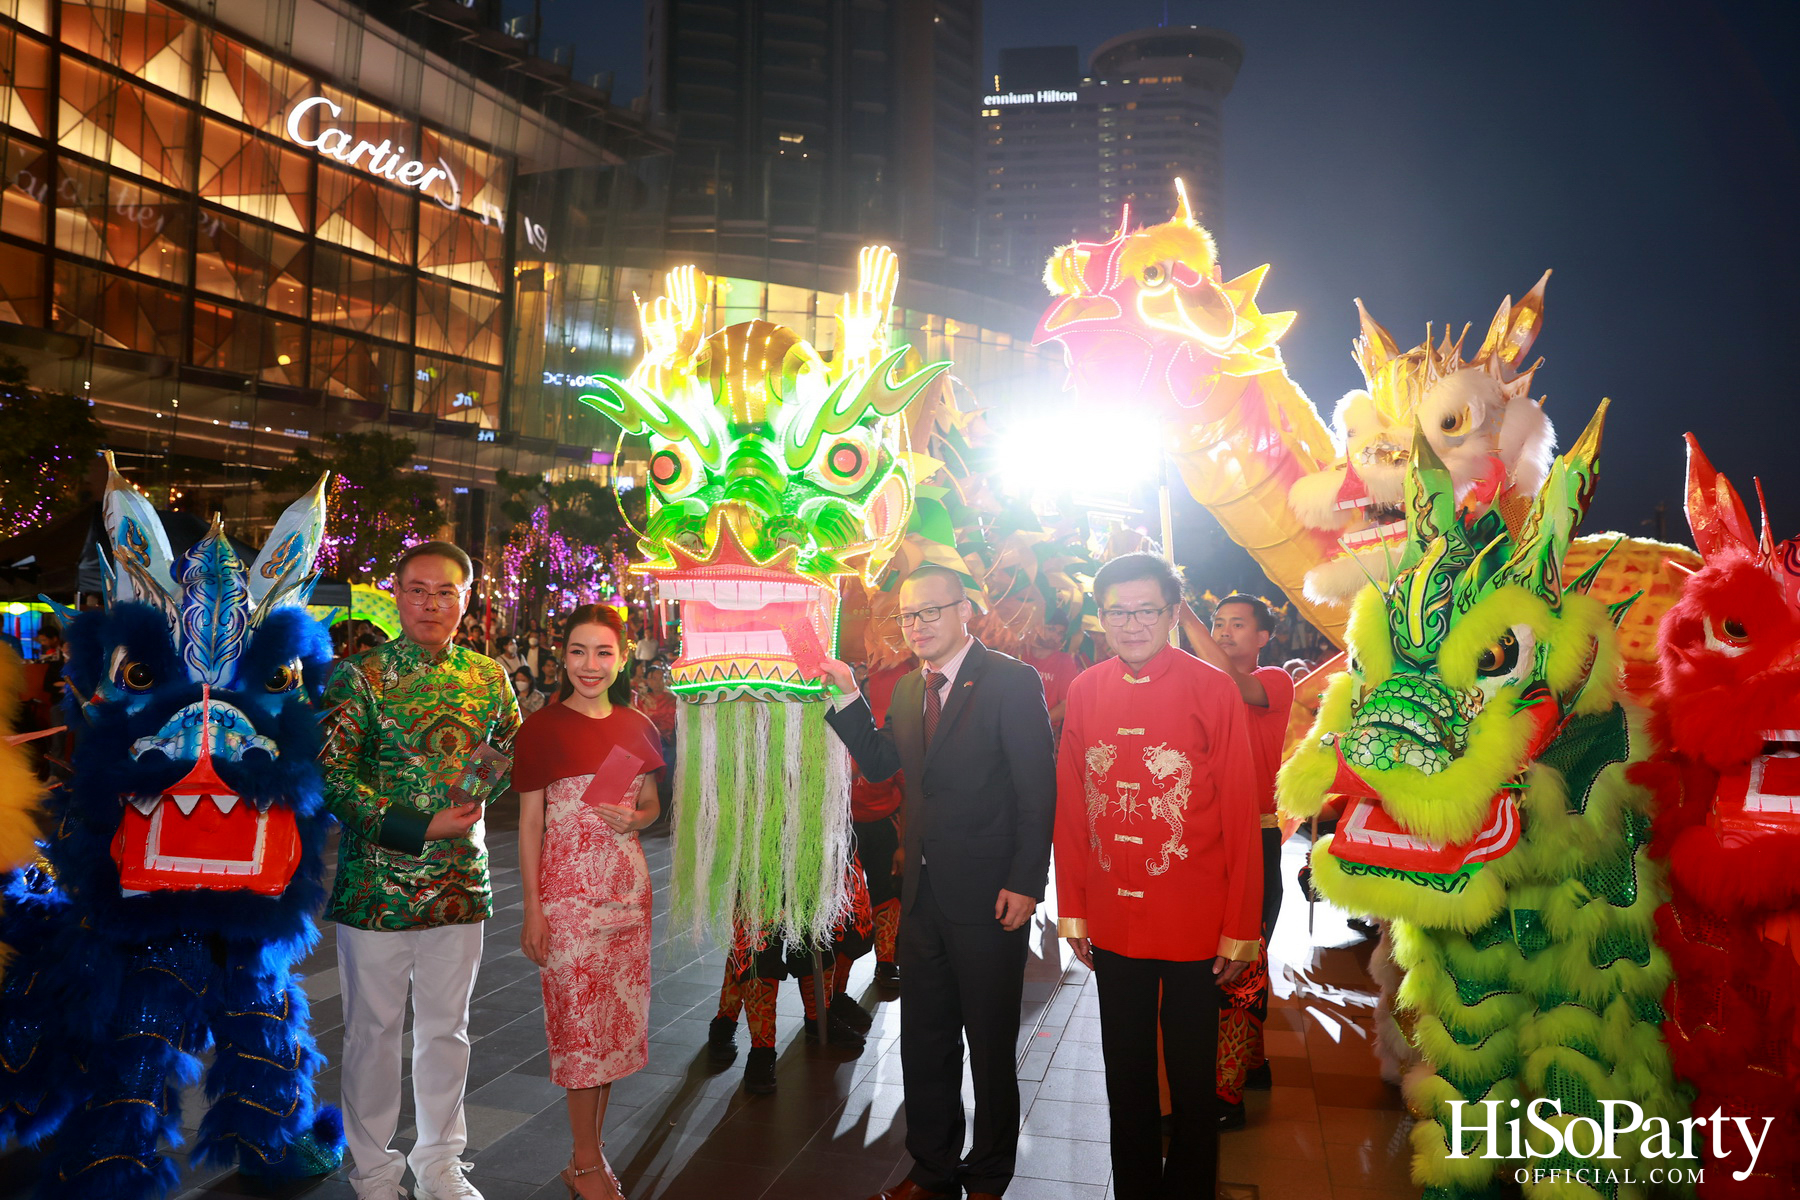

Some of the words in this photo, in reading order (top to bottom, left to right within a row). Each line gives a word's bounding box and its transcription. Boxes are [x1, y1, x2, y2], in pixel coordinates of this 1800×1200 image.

[983, 92, 1034, 105] ennium
[1037, 90, 1078, 103] Hilton
[286, 96, 447, 190] Cartier
